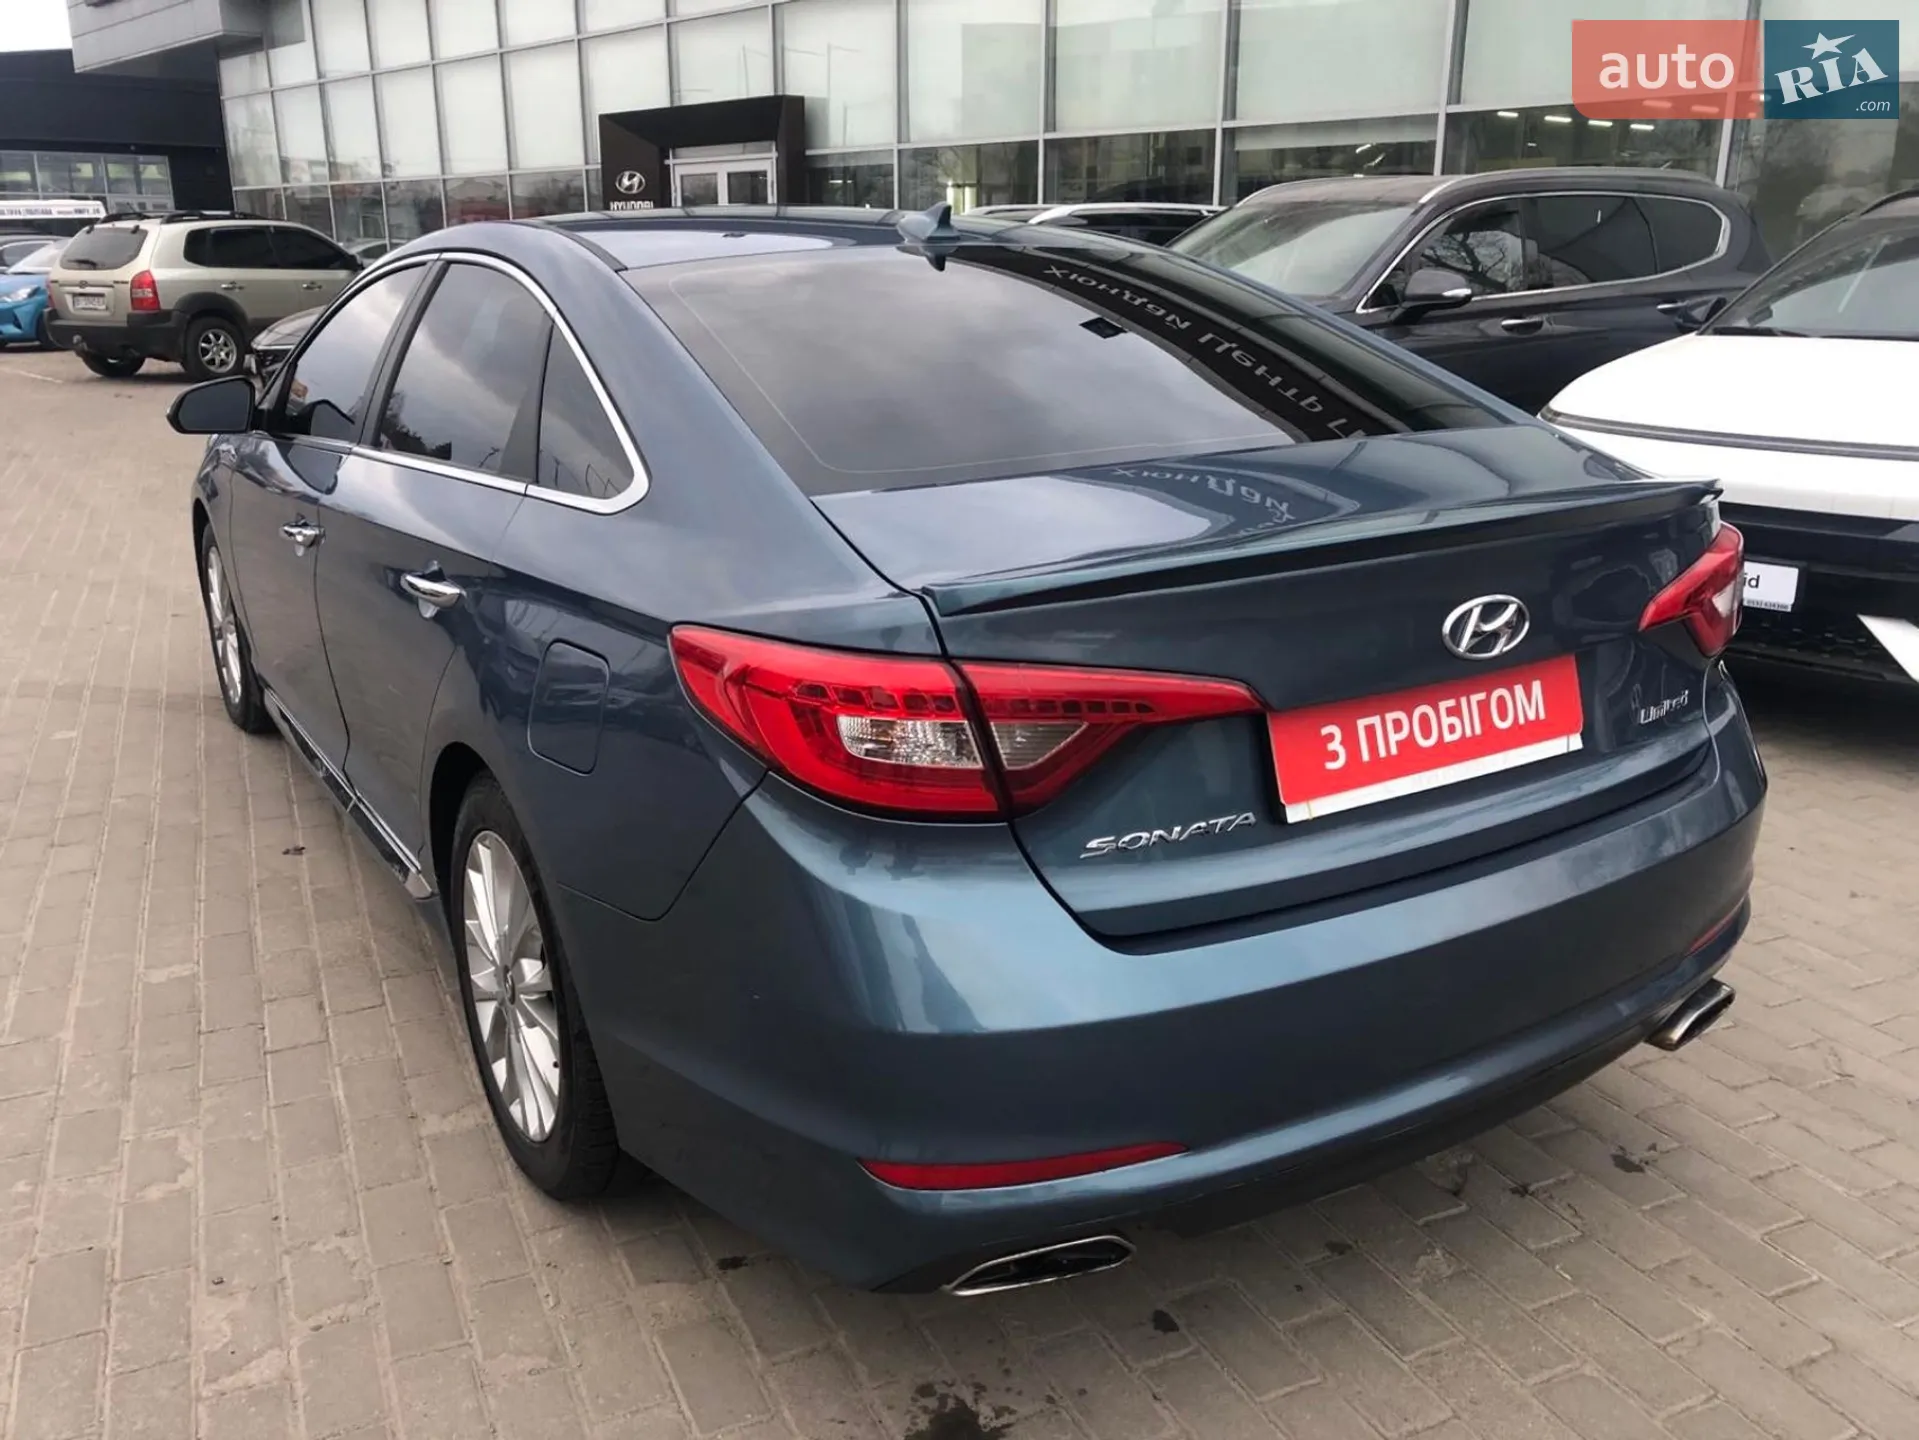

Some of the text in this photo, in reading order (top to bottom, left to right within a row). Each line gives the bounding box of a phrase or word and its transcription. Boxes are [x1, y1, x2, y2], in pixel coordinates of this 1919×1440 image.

[609, 201, 654, 211] HYUNDAI
[1743, 572, 1760, 589] id
[1356, 679, 1546, 763] ПРОБІГОМ
[1080, 812, 1257, 859] SONATA
